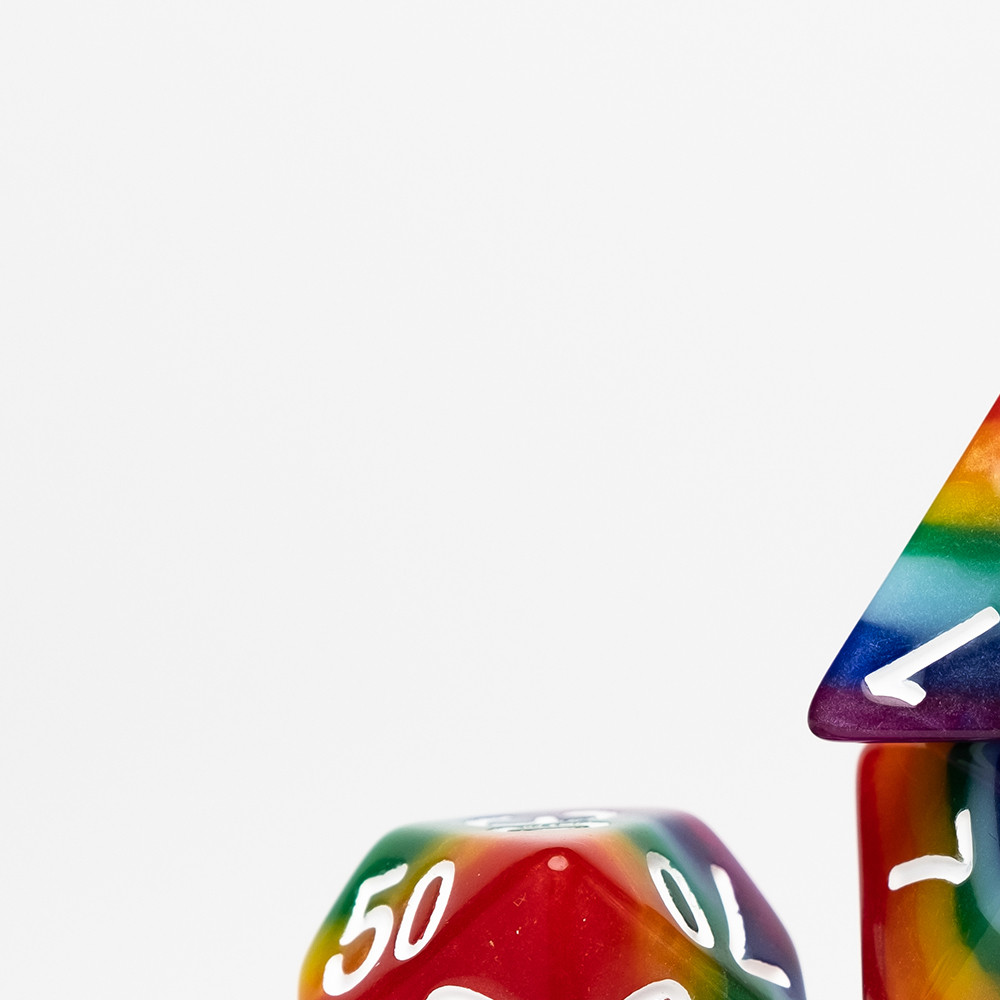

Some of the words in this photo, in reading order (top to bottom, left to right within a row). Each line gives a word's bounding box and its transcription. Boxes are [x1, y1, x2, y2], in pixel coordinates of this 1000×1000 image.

[864, 606, 1000, 707] 1
[322, 859, 456, 997] 50
[646, 851, 791, 988] 70
